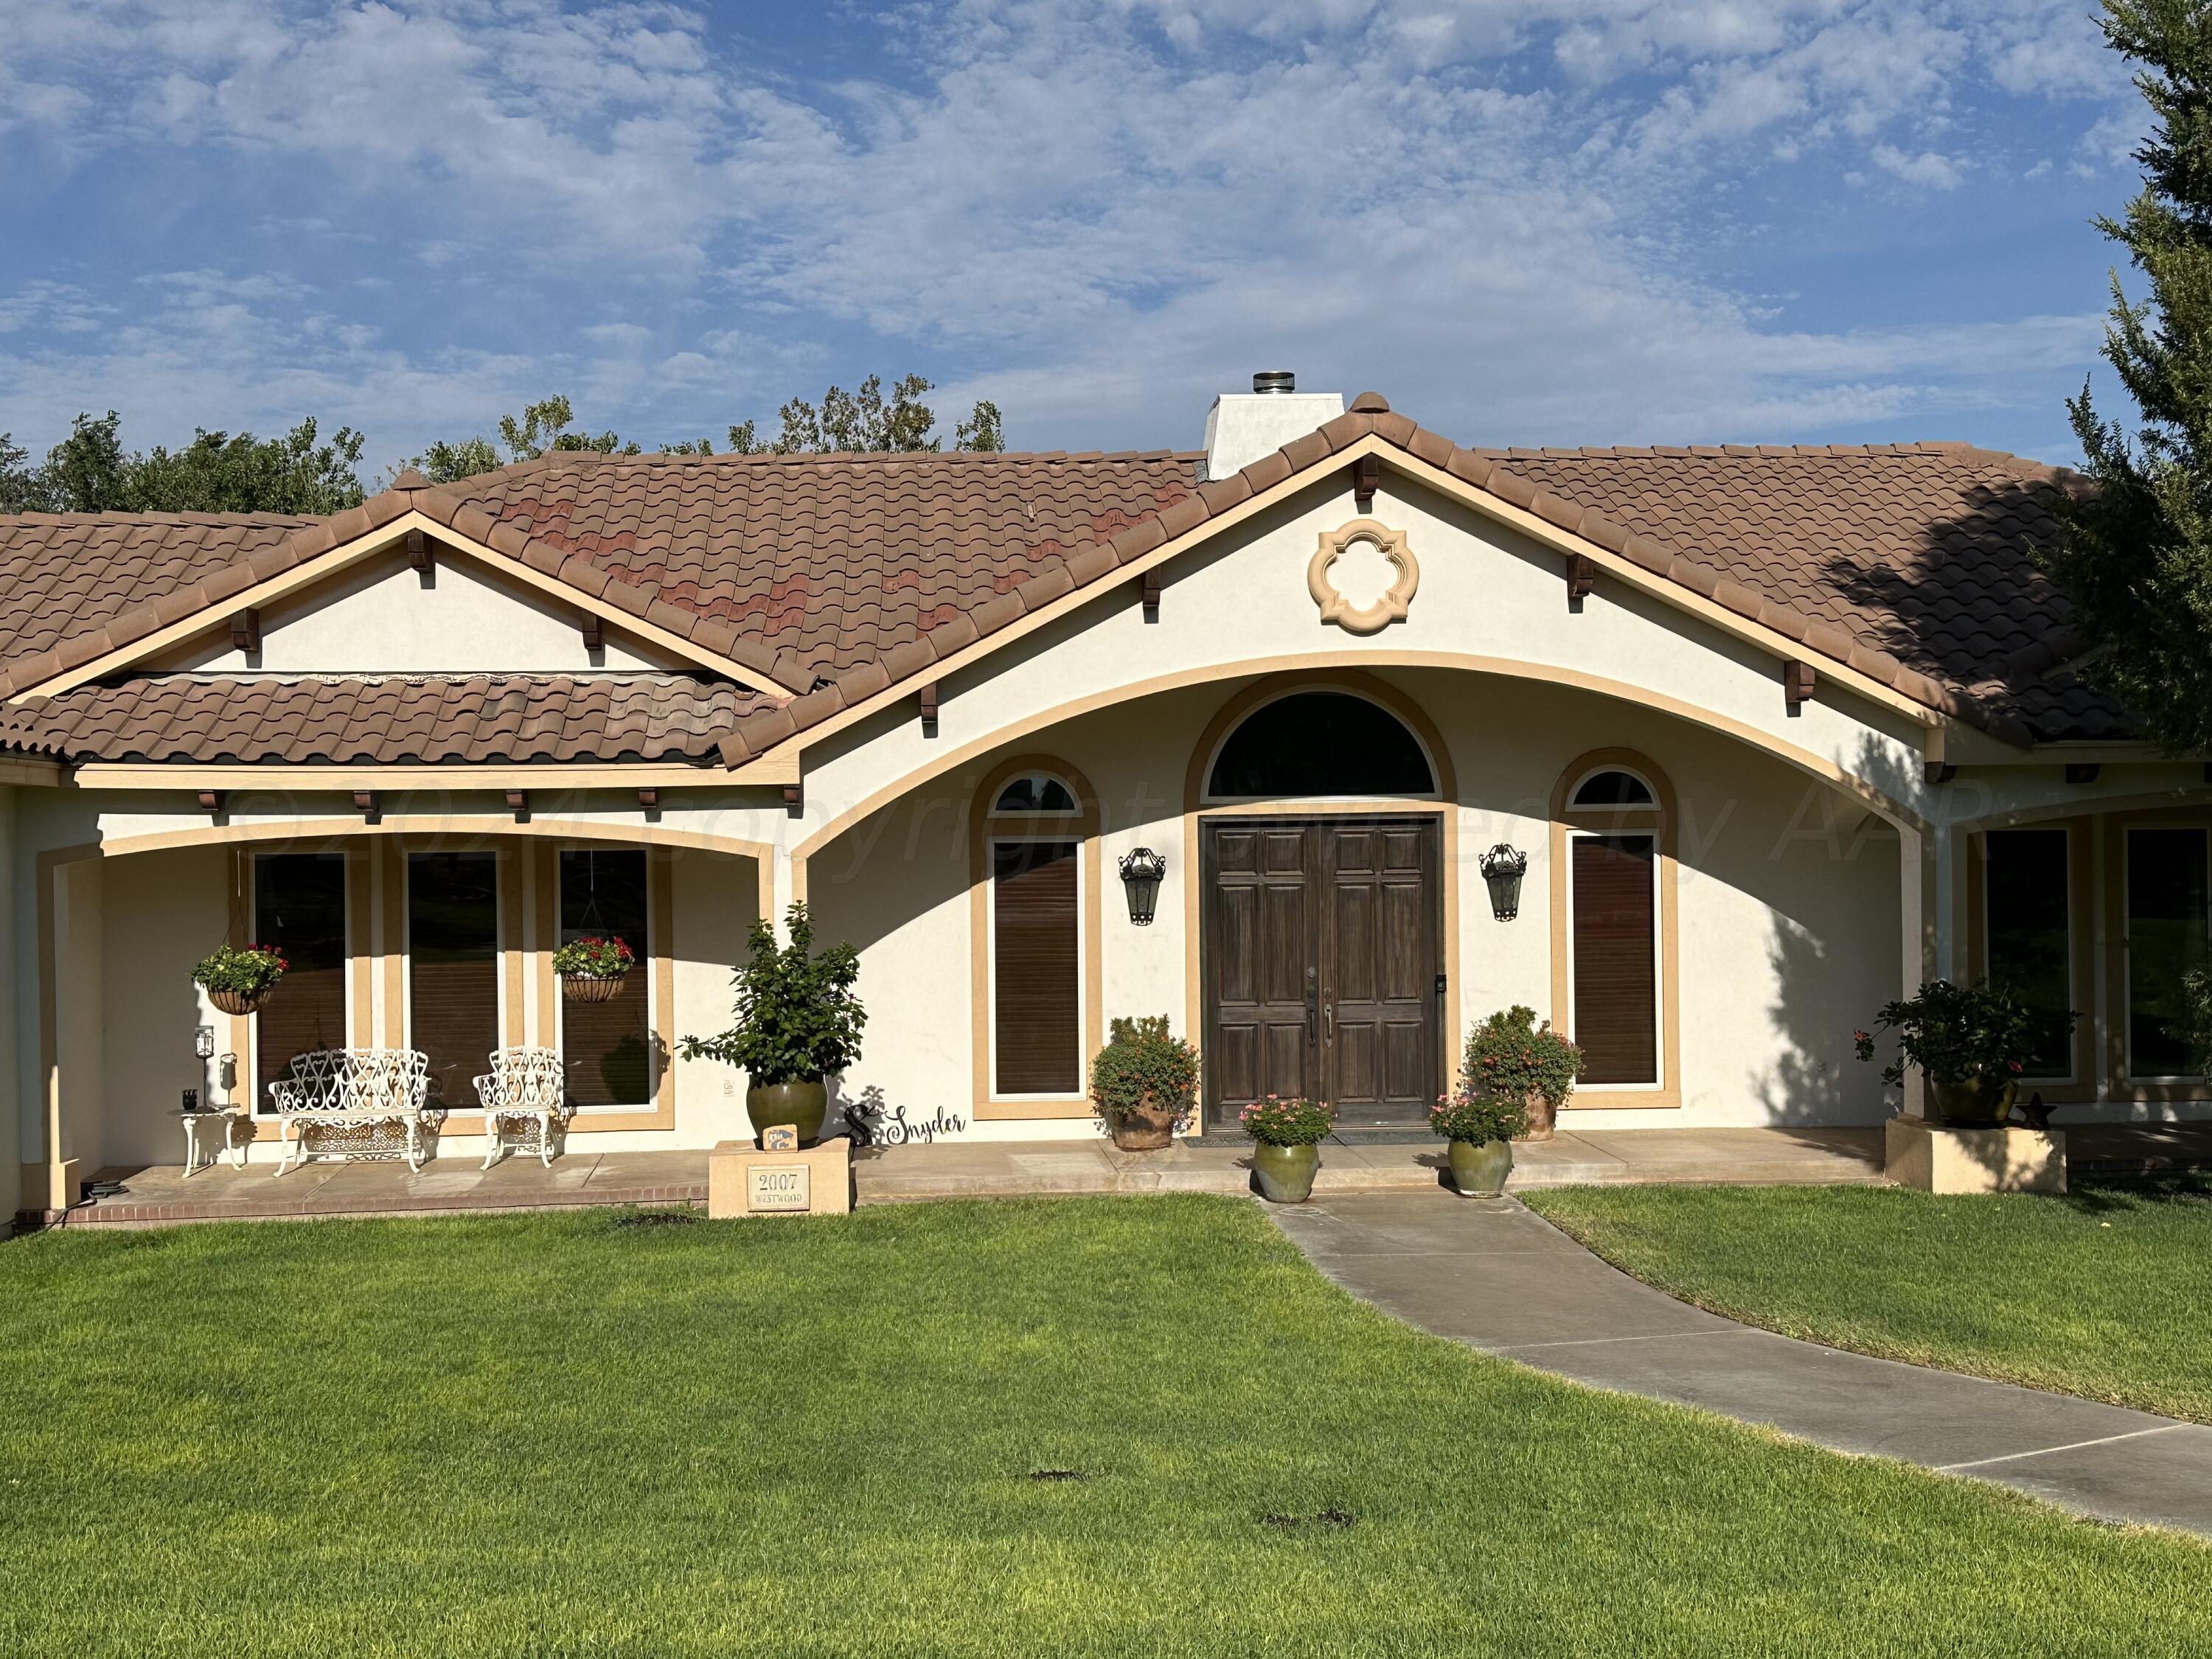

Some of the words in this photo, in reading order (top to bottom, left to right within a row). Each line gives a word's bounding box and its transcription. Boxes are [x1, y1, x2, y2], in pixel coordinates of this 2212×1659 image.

[884, 1105, 966, 1144] Snyder
[759, 1173, 798, 1191] 2007
[755, 1193, 802, 1203] WESTWOOD
